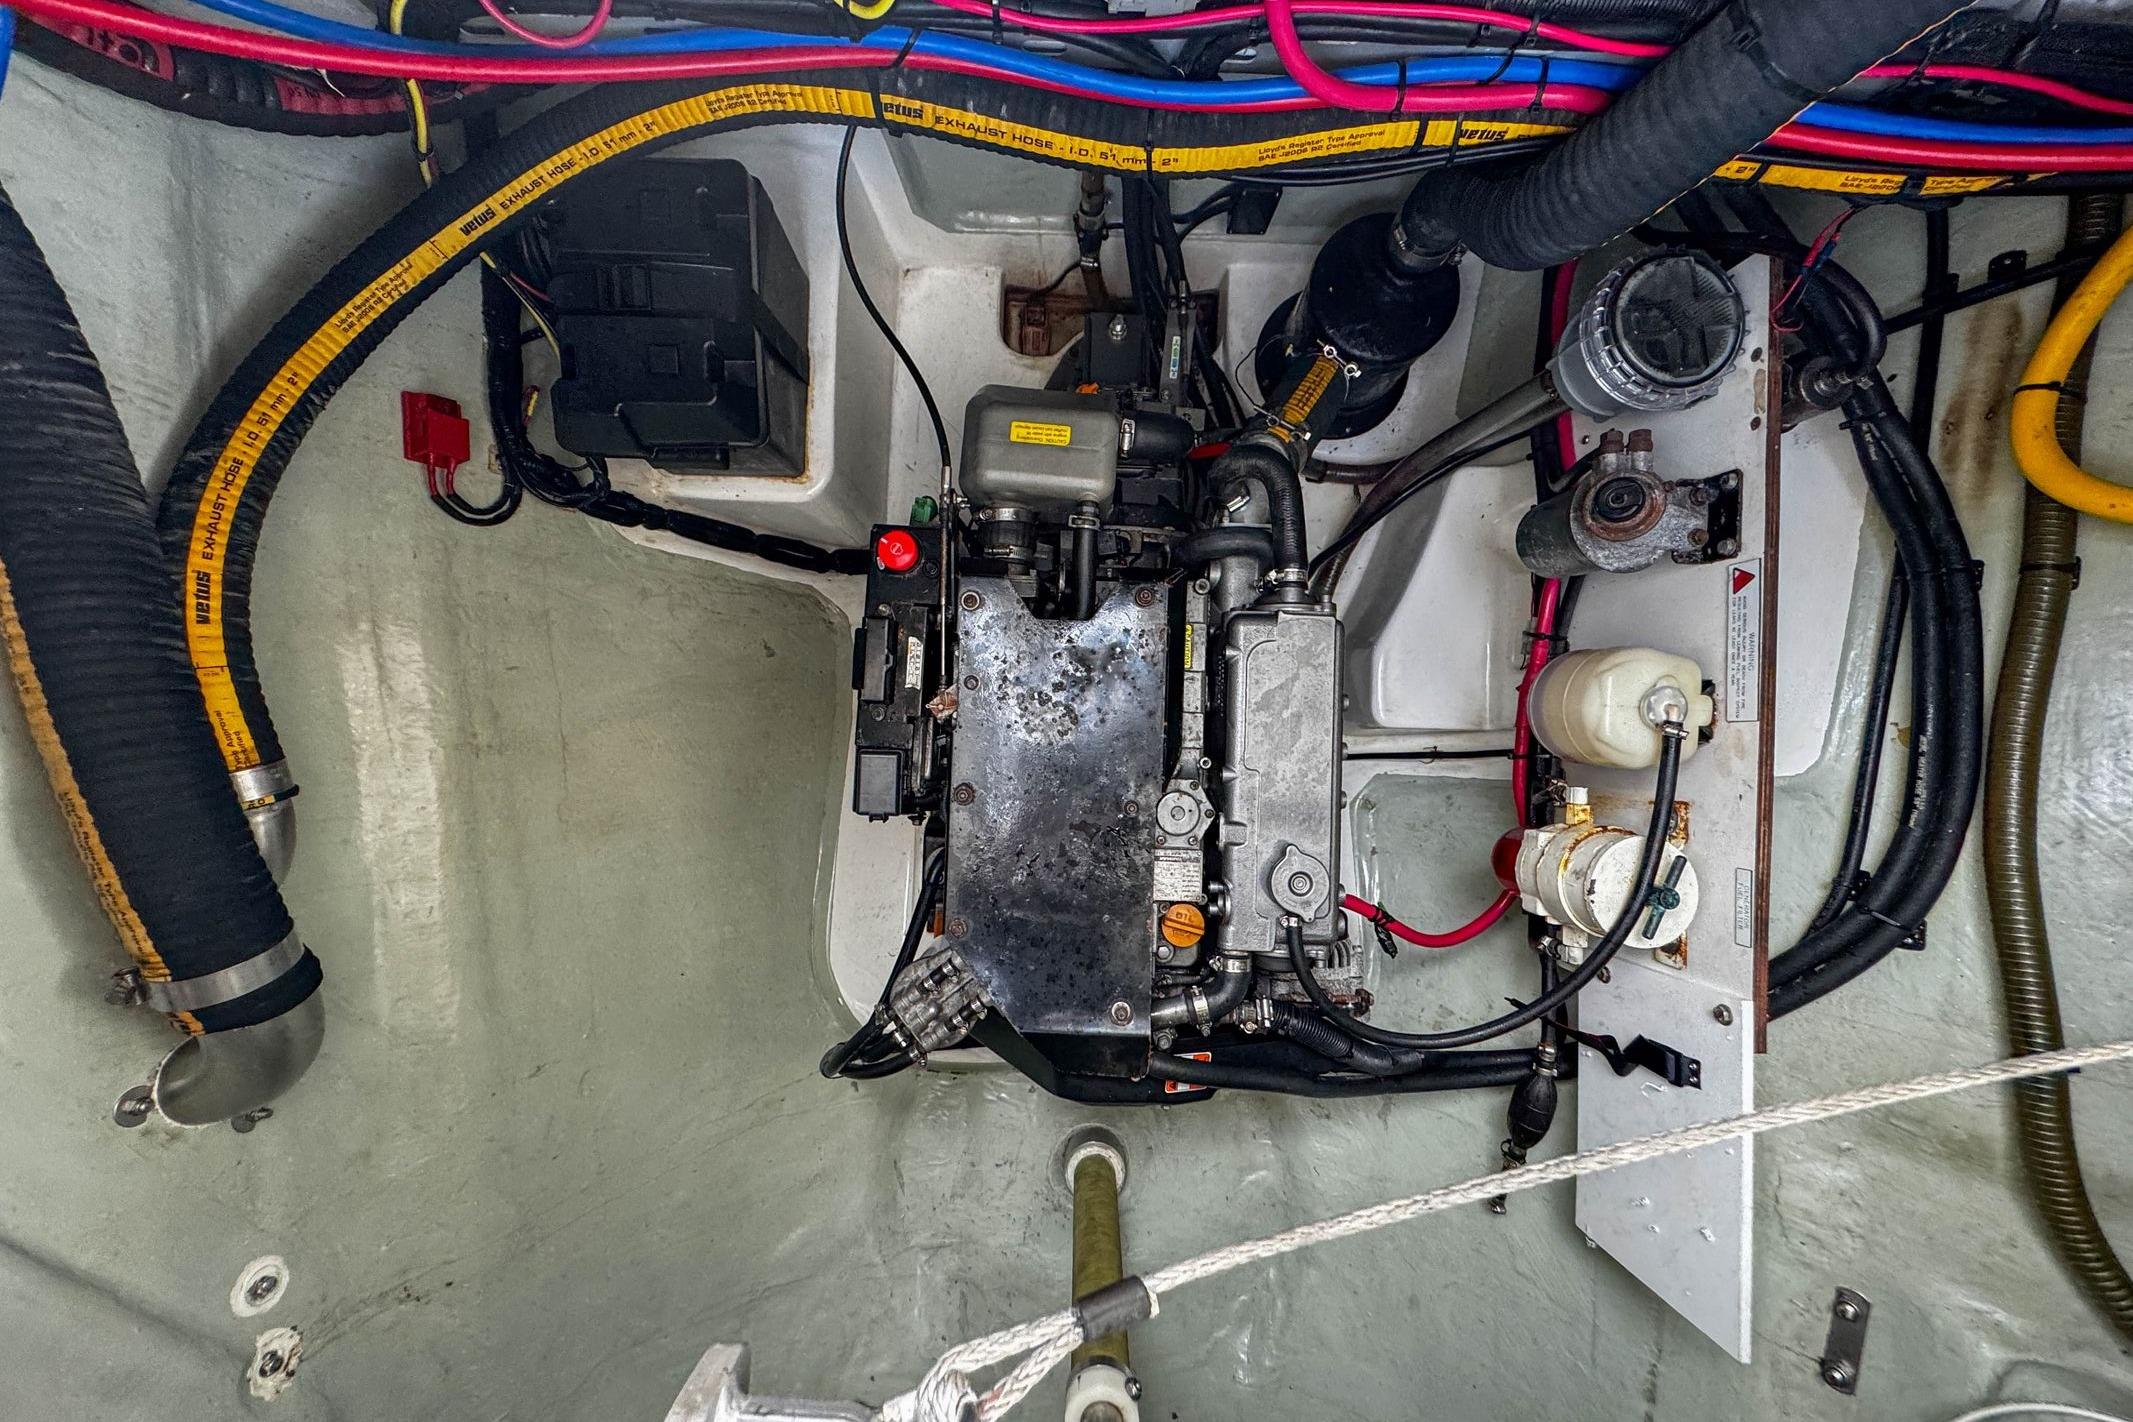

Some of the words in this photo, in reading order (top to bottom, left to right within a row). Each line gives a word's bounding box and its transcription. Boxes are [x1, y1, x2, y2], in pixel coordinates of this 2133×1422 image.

[883, 102, 924, 120] etus
[935, 115, 1008, 140] EXHAUST
[1012, 133, 1054, 151] HOSE
[1068, 145, 1094, 158] I.D.
[1099, 150, 1117, 162] 51
[1288, 138, 1325, 150] Register
[1327, 134, 1346, 145] Type
[1348, 129, 1386, 141] Approval
[1258, 153, 1277, 162] SAE
[459, 203, 497, 236] vetus
[499, 175, 547, 211] EXHAUST
[547, 158, 577, 180] HOSE
[584, 147, 603, 161] I.D.
[602, 138, 618, 151] 51
[618, 130, 637, 144] mm
[192, 569, 212, 625] vetus
[202, 493, 228, 561] EXHAUST
[220, 457, 244, 493] HOSE
[242, 431, 262, 449] I.D.
[257, 411, 272, 427] 51
[270, 393, 287, 411] mm
[1748, 632, 1756, 672] WARNING
